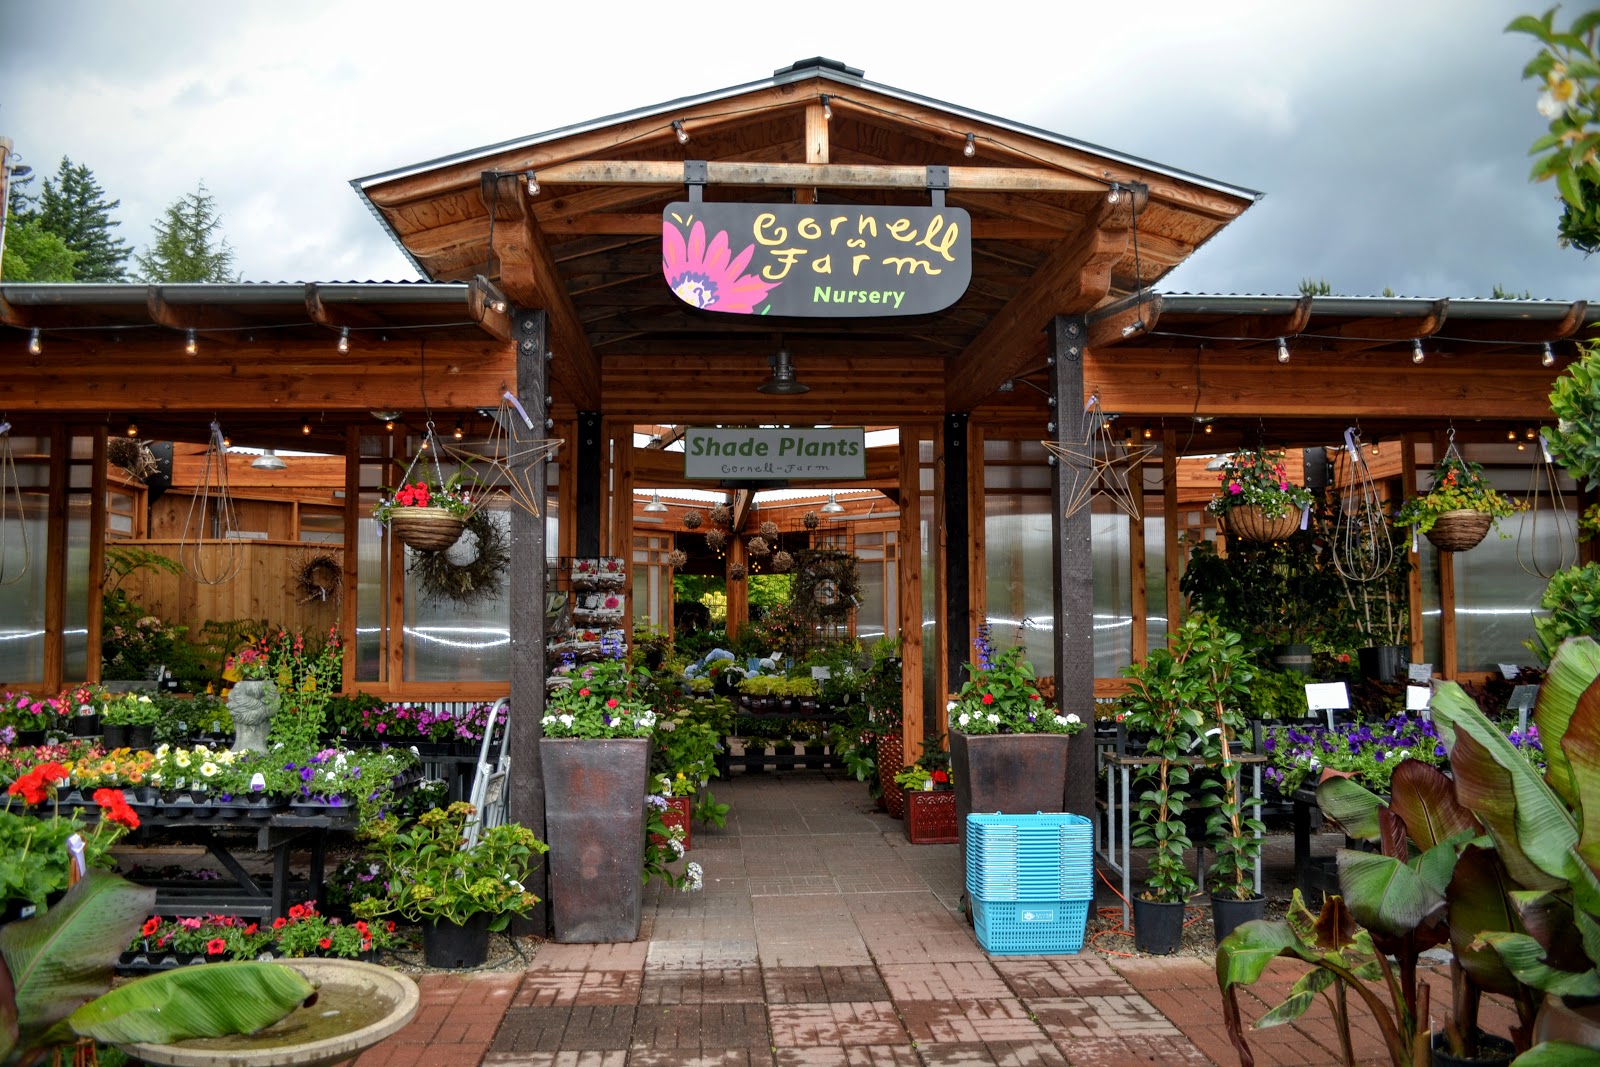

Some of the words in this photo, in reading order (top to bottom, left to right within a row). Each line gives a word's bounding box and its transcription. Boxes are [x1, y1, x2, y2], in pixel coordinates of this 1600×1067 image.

[753, 213, 959, 262] Cornell
[762, 247, 942, 280] Farm
[813, 286, 906, 308] Nursery
[691, 436, 769, 457] Shade
[778, 437, 859, 457] Plants
